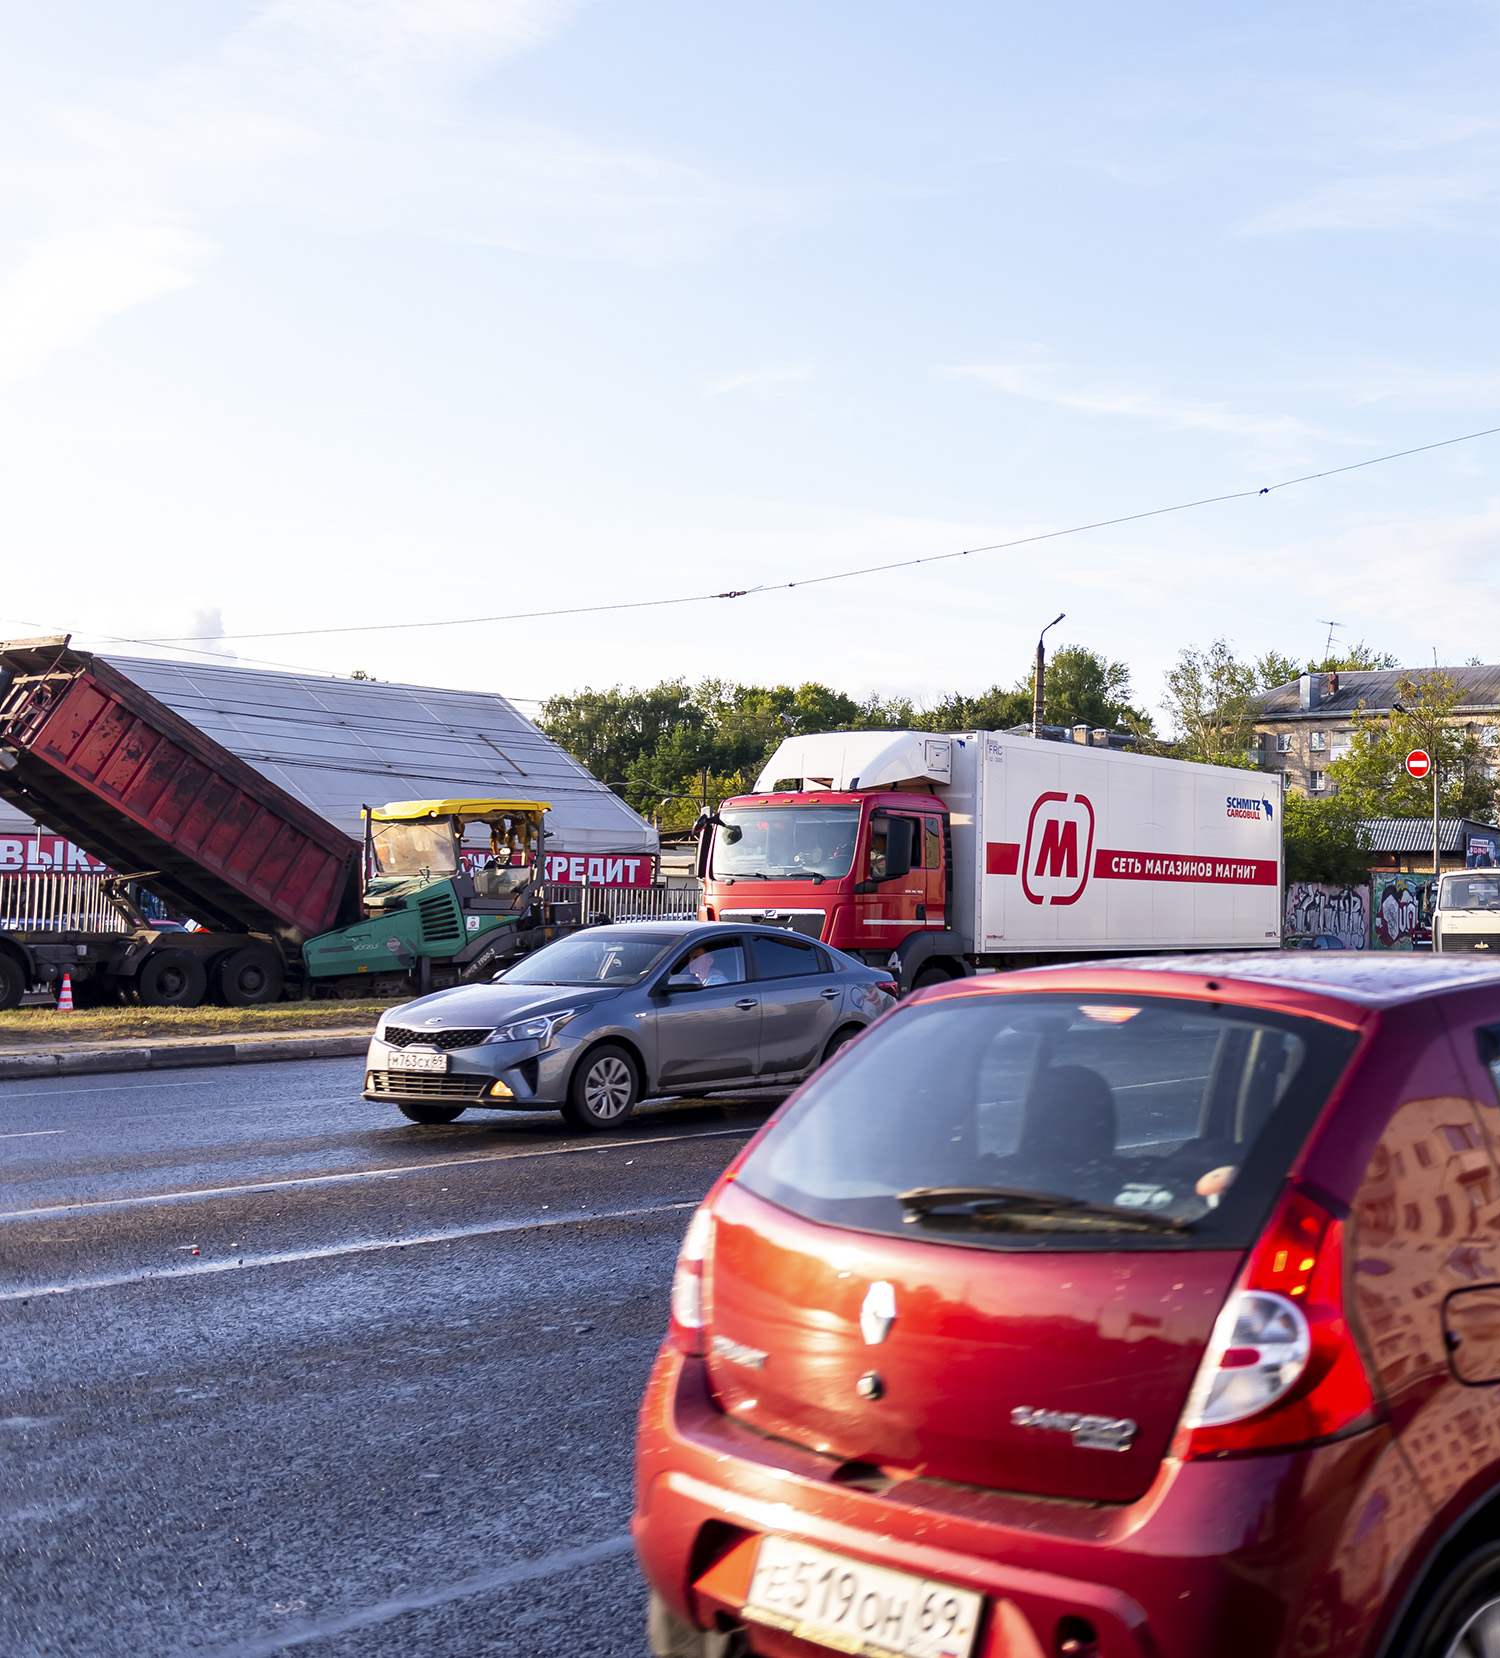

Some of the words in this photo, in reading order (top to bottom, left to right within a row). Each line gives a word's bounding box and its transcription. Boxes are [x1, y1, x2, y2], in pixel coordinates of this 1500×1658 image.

[988, 745, 1003, 756] FRC
[1226, 796, 1261, 811] SCHMITZ
[1226, 808, 1261, 820] CARGOBULL
[1111, 857, 1142, 874] СЕТЬ
[1145, 859, 1212, 877] МАГАЗИНОВ
[1215, 863, 1257, 879] МАГНИТ
[917, 1592, 961, 1639] 69
